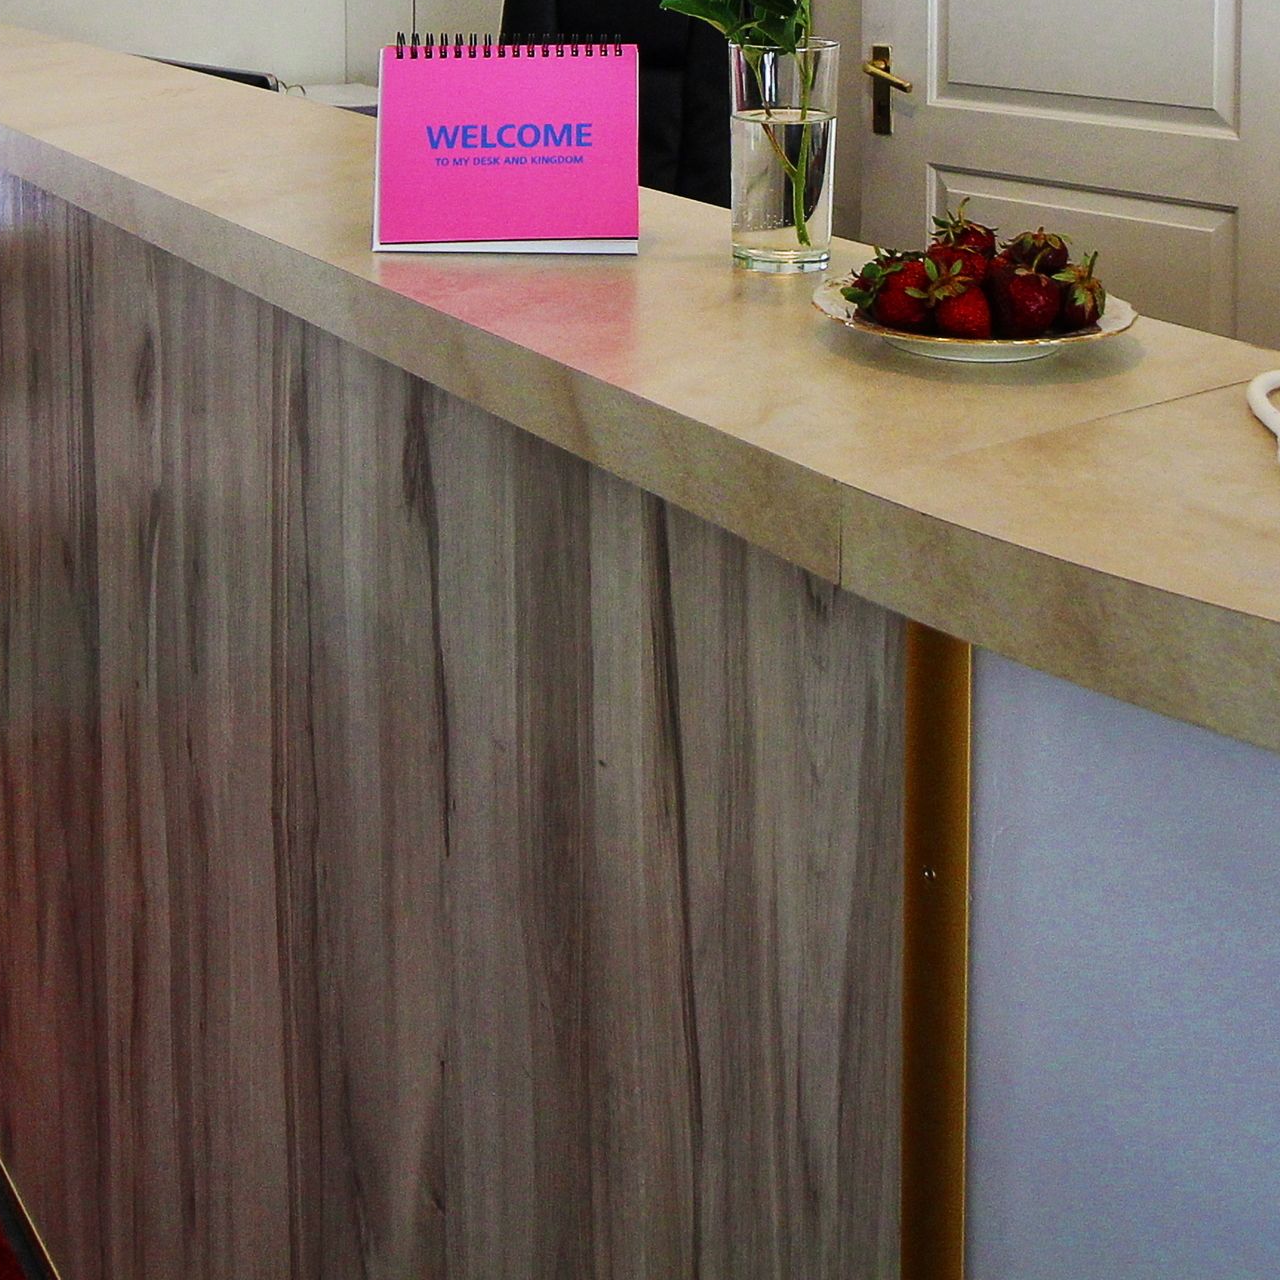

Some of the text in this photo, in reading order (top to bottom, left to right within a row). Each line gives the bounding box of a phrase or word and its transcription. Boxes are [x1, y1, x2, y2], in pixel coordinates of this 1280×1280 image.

[426, 123, 593, 149] WELCOME
[435, 155, 584, 167] TO MY DESK AND KINGDOM
